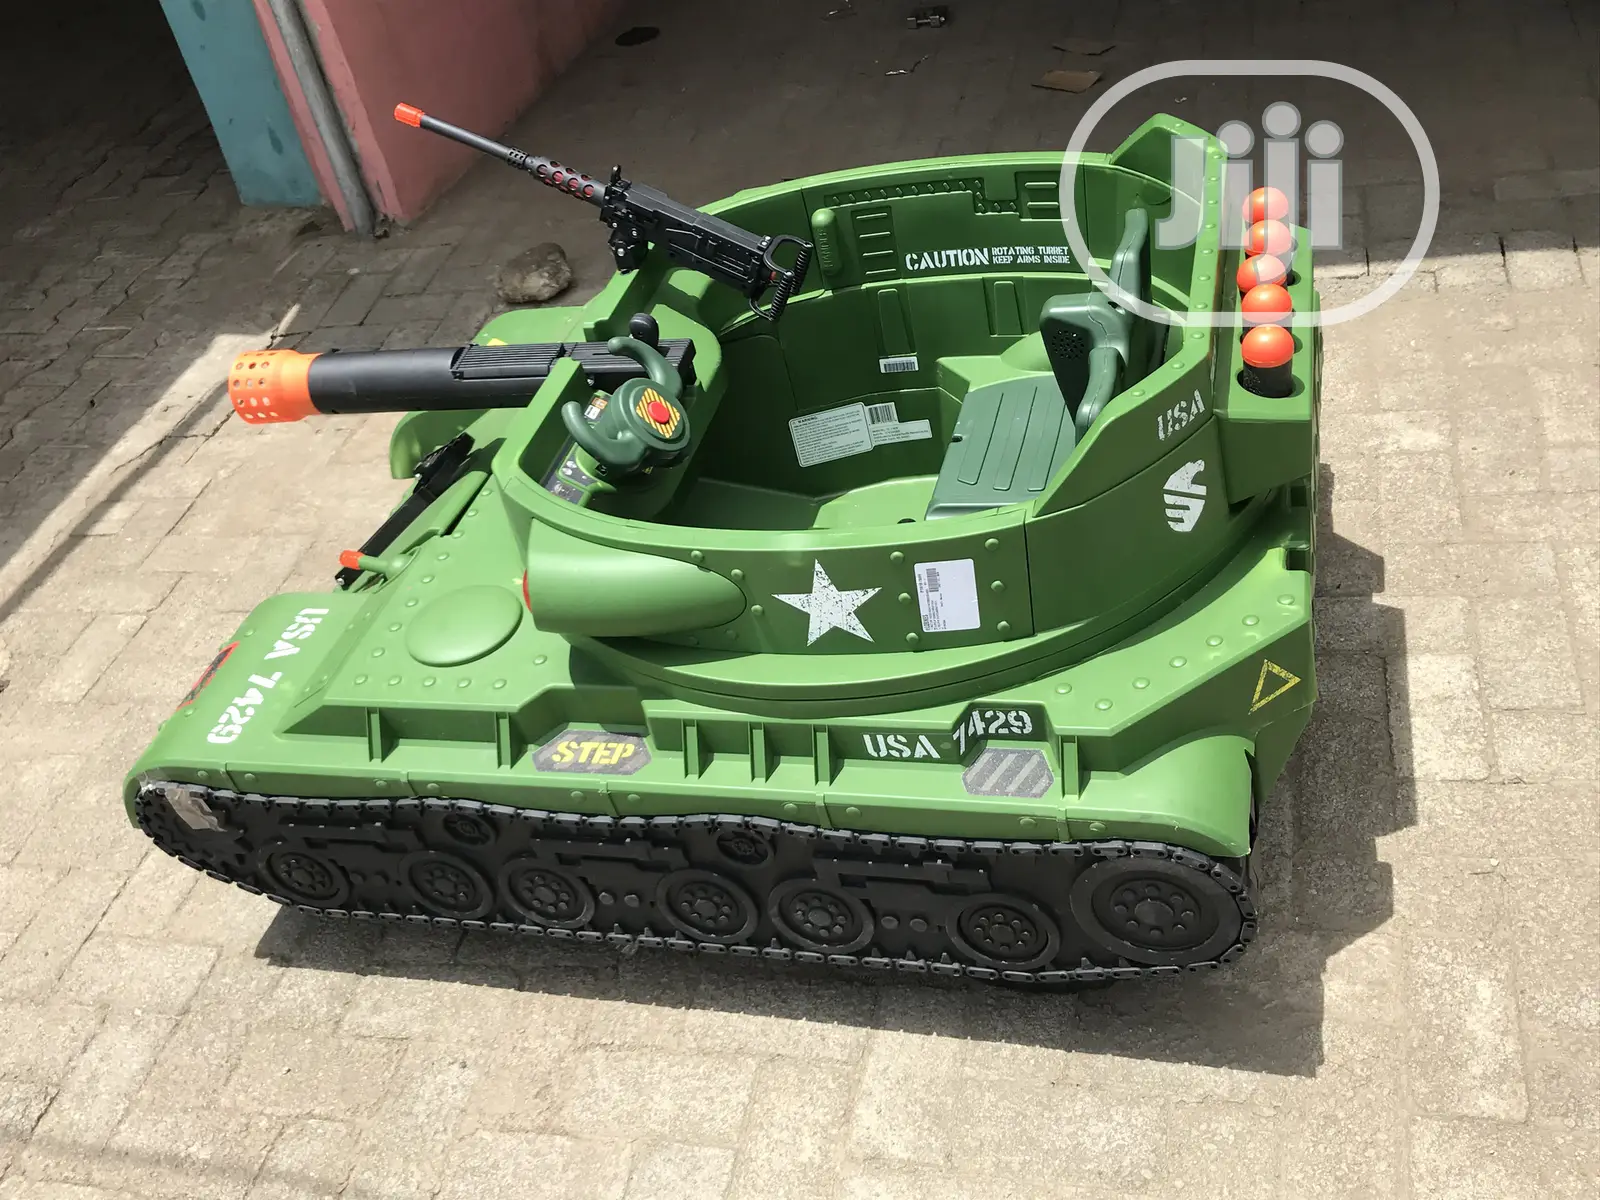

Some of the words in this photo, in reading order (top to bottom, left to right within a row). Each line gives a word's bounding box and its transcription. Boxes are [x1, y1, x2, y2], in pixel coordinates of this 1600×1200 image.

[905, 247, 990, 271] CAUTION
[991, 246, 1035, 256] ROTATING
[1037, 246, 1069, 255] TURRET
[992, 255, 1013, 264] KEEP
[1016, 255, 1041, 264] ARMS
[1043, 255, 1071, 264] INSIDE
[1157, 388, 1206, 442] USA
[263, 607, 329, 660] USA
[206, 671, 283, 744] 7429
[862, 734, 941, 759] USA
[952, 709, 1033, 756] 7429
[551, 741, 635, 765] STEP
